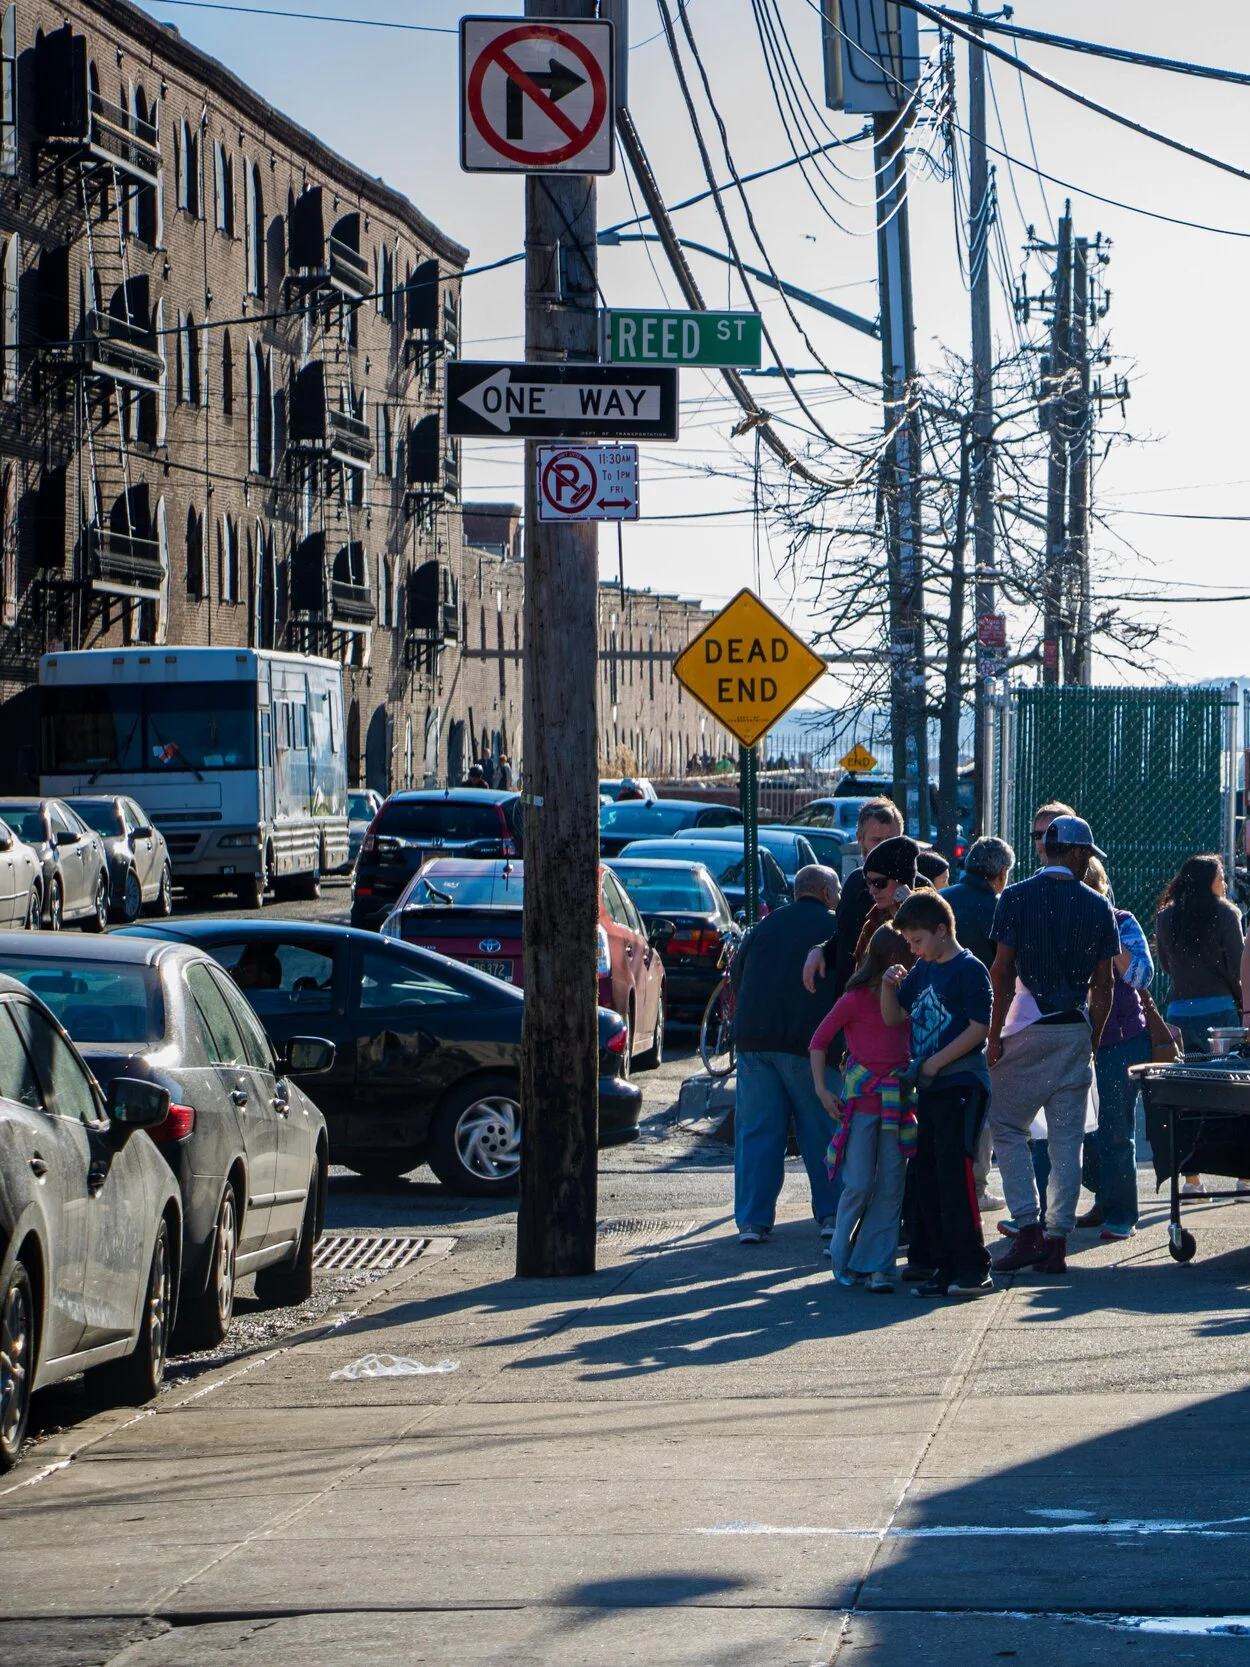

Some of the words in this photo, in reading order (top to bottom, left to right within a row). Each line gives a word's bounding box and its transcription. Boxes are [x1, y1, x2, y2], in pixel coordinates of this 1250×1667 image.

[617, 317, 701, 359] REED
[717, 319, 747, 341] ST
[482, 386, 547, 415] ONE
[578, 388, 647, 417] WAY
[610, 485, 624, 494] FRI
[705, 638, 790, 664] DEAD
[717, 677, 778, 703] END
[847, 756, 871, 768] END
